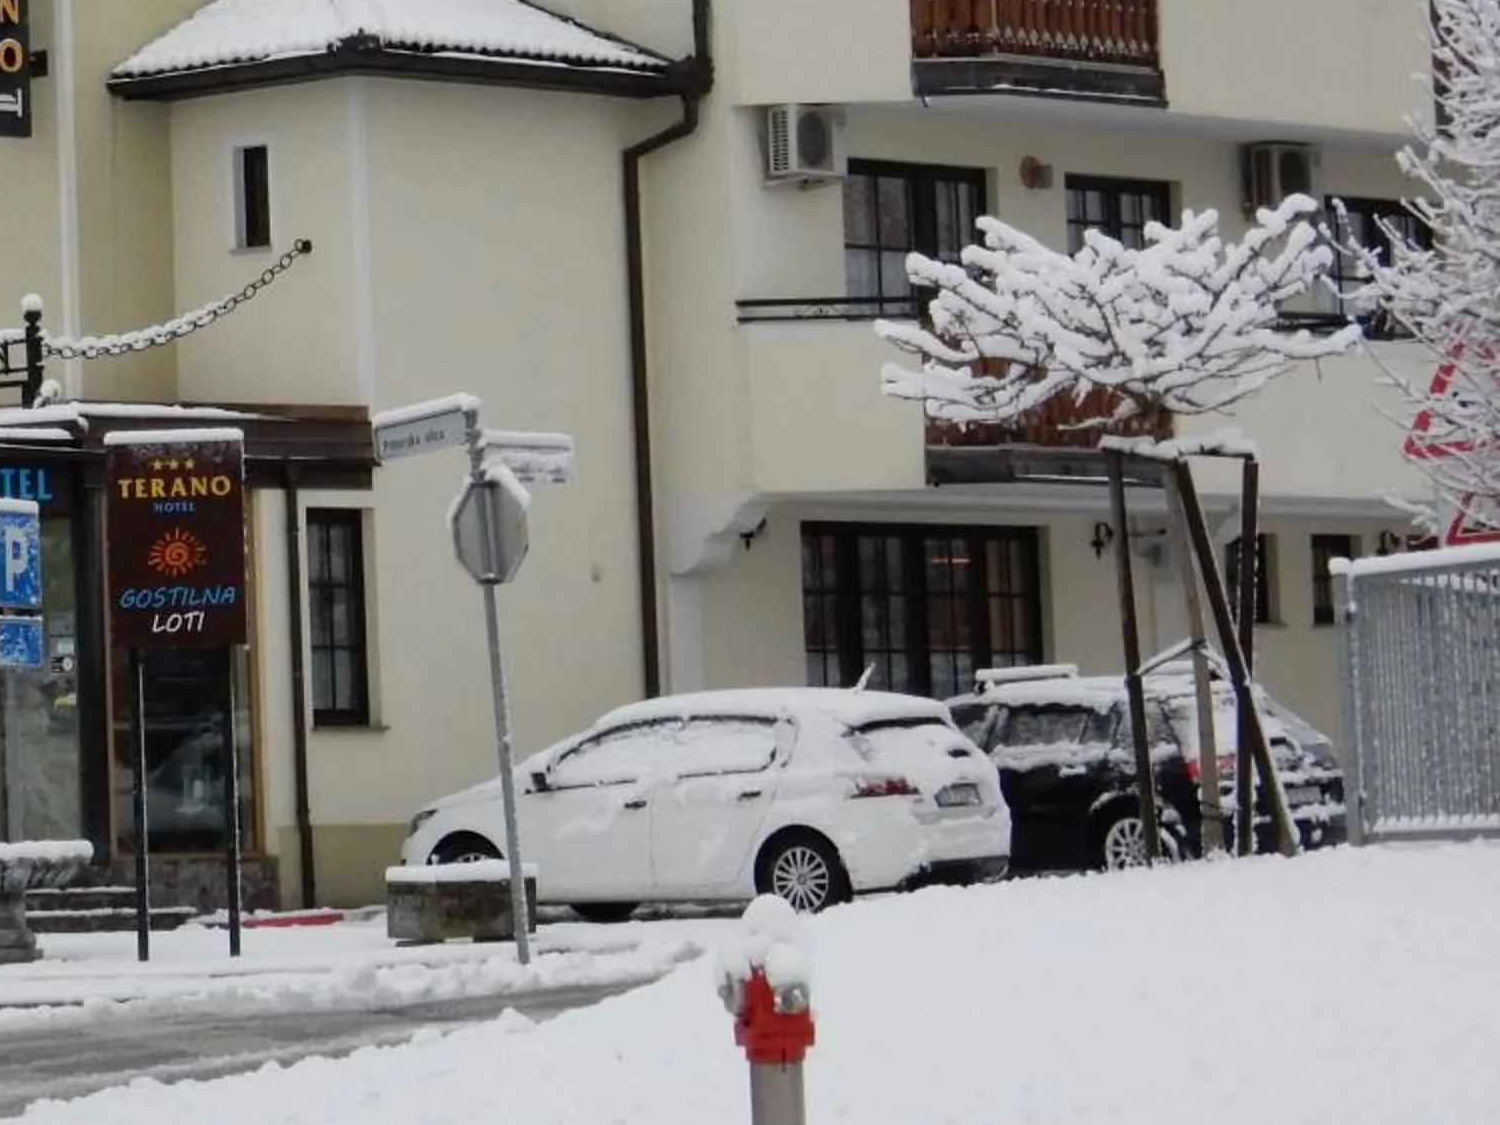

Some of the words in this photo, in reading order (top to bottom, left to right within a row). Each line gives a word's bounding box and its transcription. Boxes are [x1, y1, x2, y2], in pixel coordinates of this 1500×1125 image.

[117, 475, 232, 499] TERANO
[153, 501, 196, 513] HOTEL
[5, 527, 29, 592] P
[119, 586, 237, 609] GOSTILNA
[152, 611, 205, 633] LOTI
